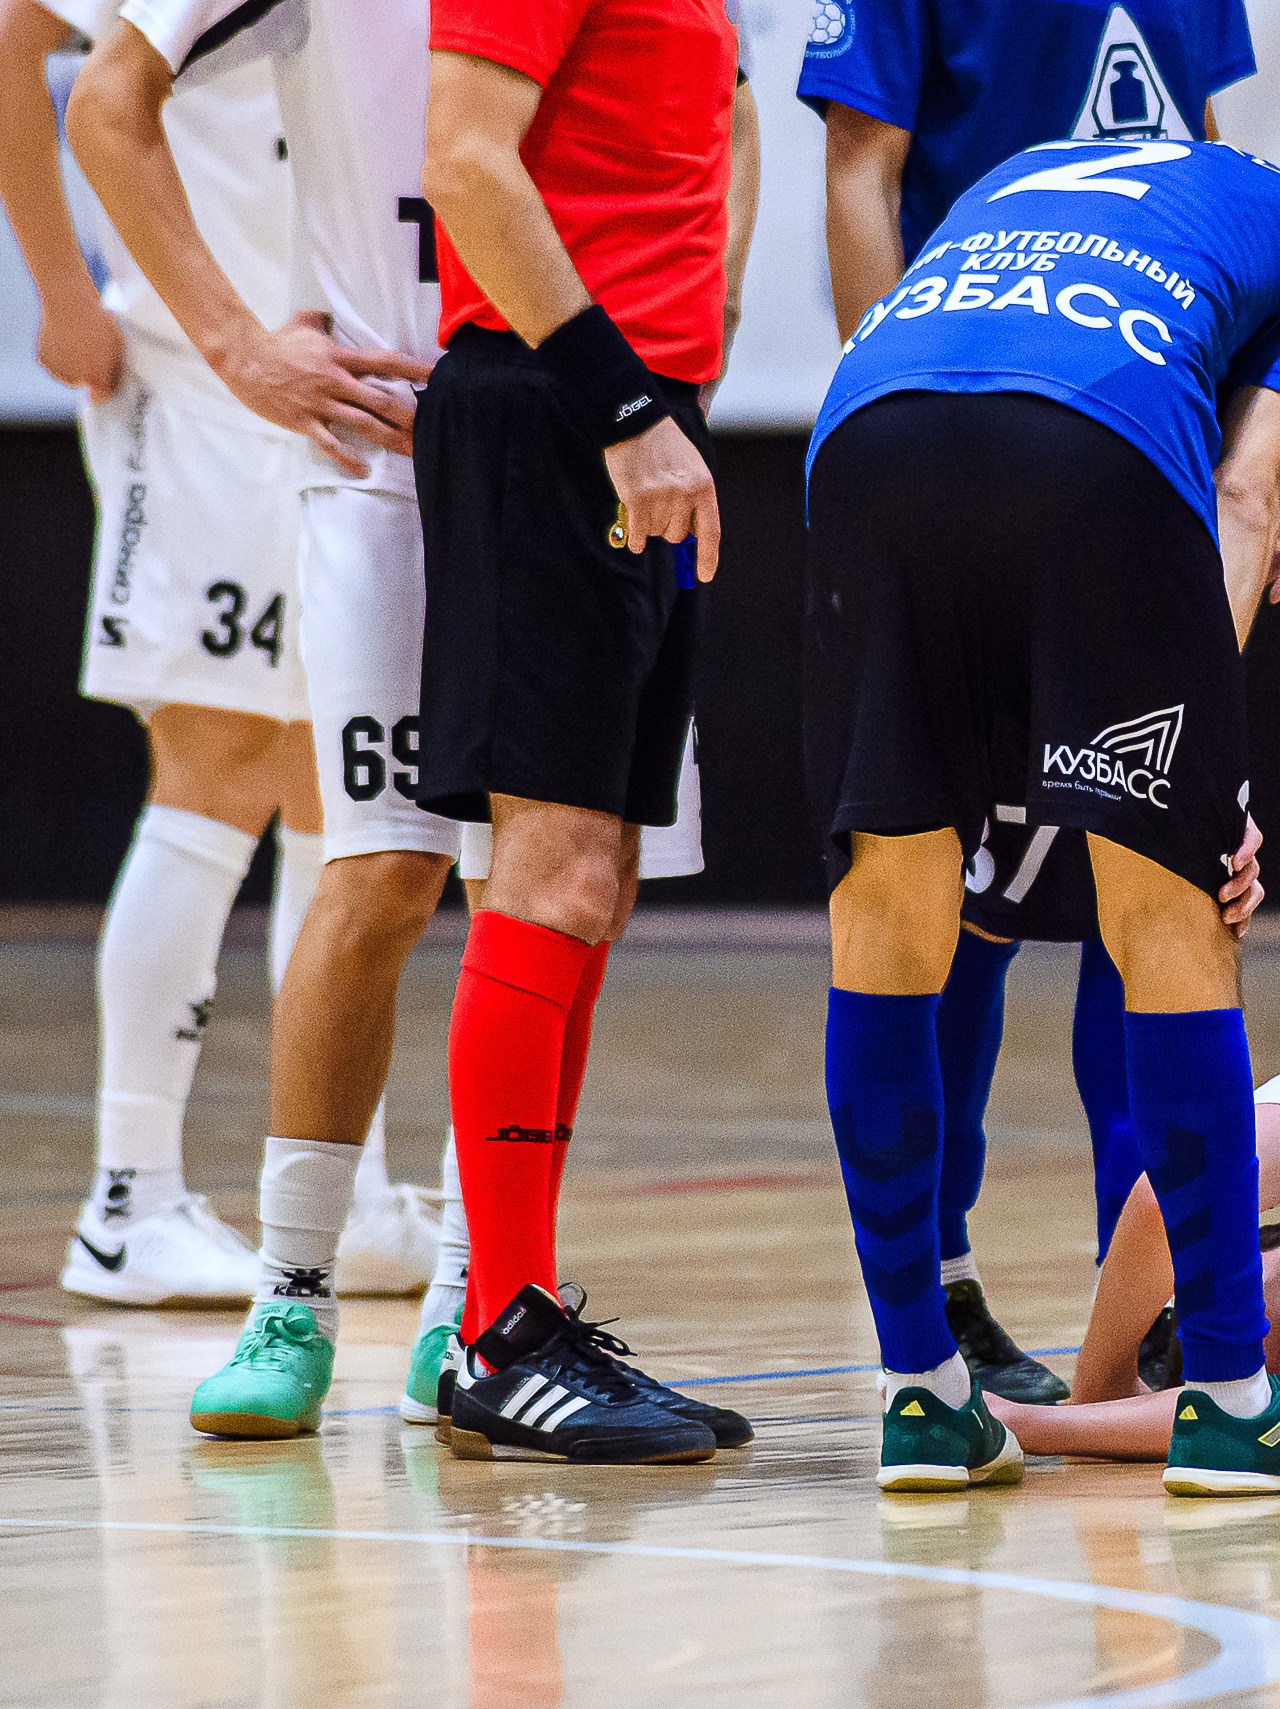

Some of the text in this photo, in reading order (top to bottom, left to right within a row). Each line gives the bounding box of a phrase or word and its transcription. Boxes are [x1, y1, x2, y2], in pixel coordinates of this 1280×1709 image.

[961, 252, 1061, 272] КЛУБ
[616, 395, 653, 422] JÖGEL
[203, 580, 288, 668] 34
[341, 715, 420, 803] 69
[1042, 780, 1073, 790] время
[1075, 780, 1093, 793] быть
[1043, 743, 1171, 809] КУЗБАСС
[501, 1305, 528, 1335] adidas
